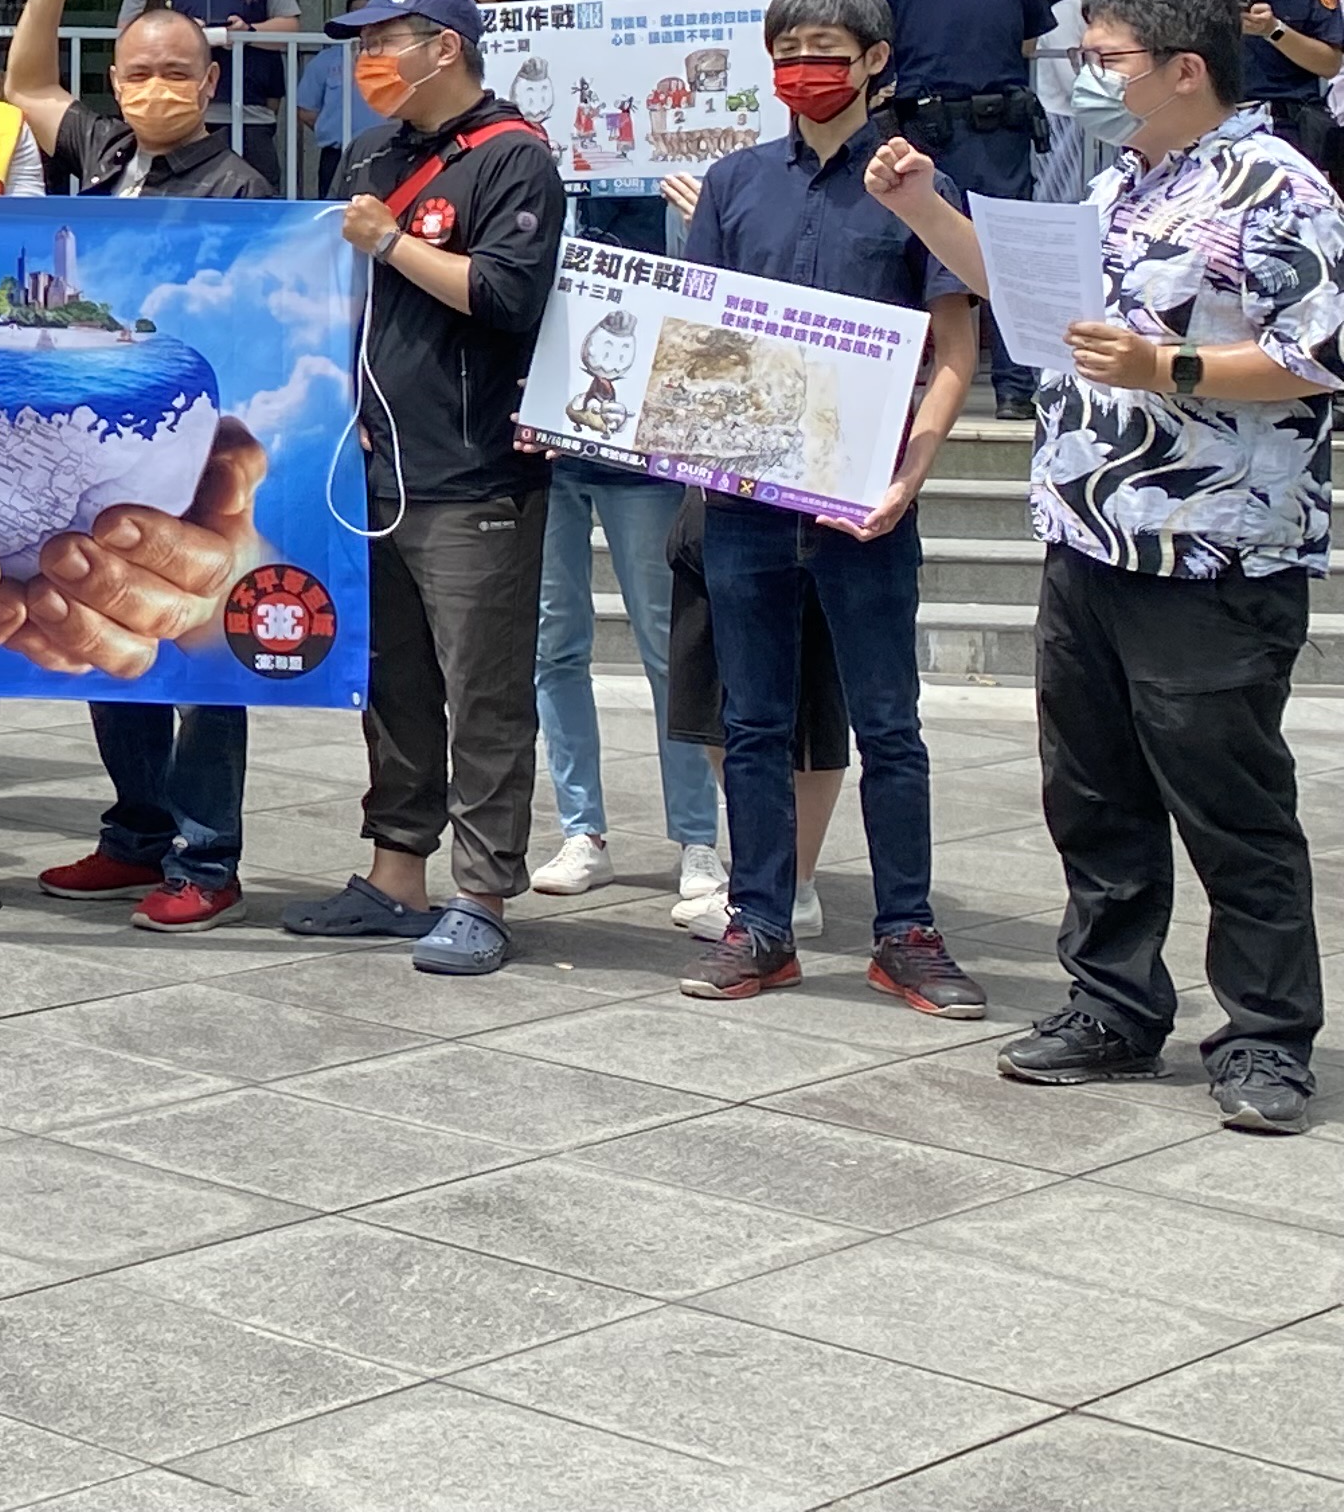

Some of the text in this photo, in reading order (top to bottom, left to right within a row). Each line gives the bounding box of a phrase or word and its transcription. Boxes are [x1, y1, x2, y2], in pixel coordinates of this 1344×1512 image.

[557, 276, 623, 305] 第十三期
[560, 242, 719, 302] 認知作戰報
